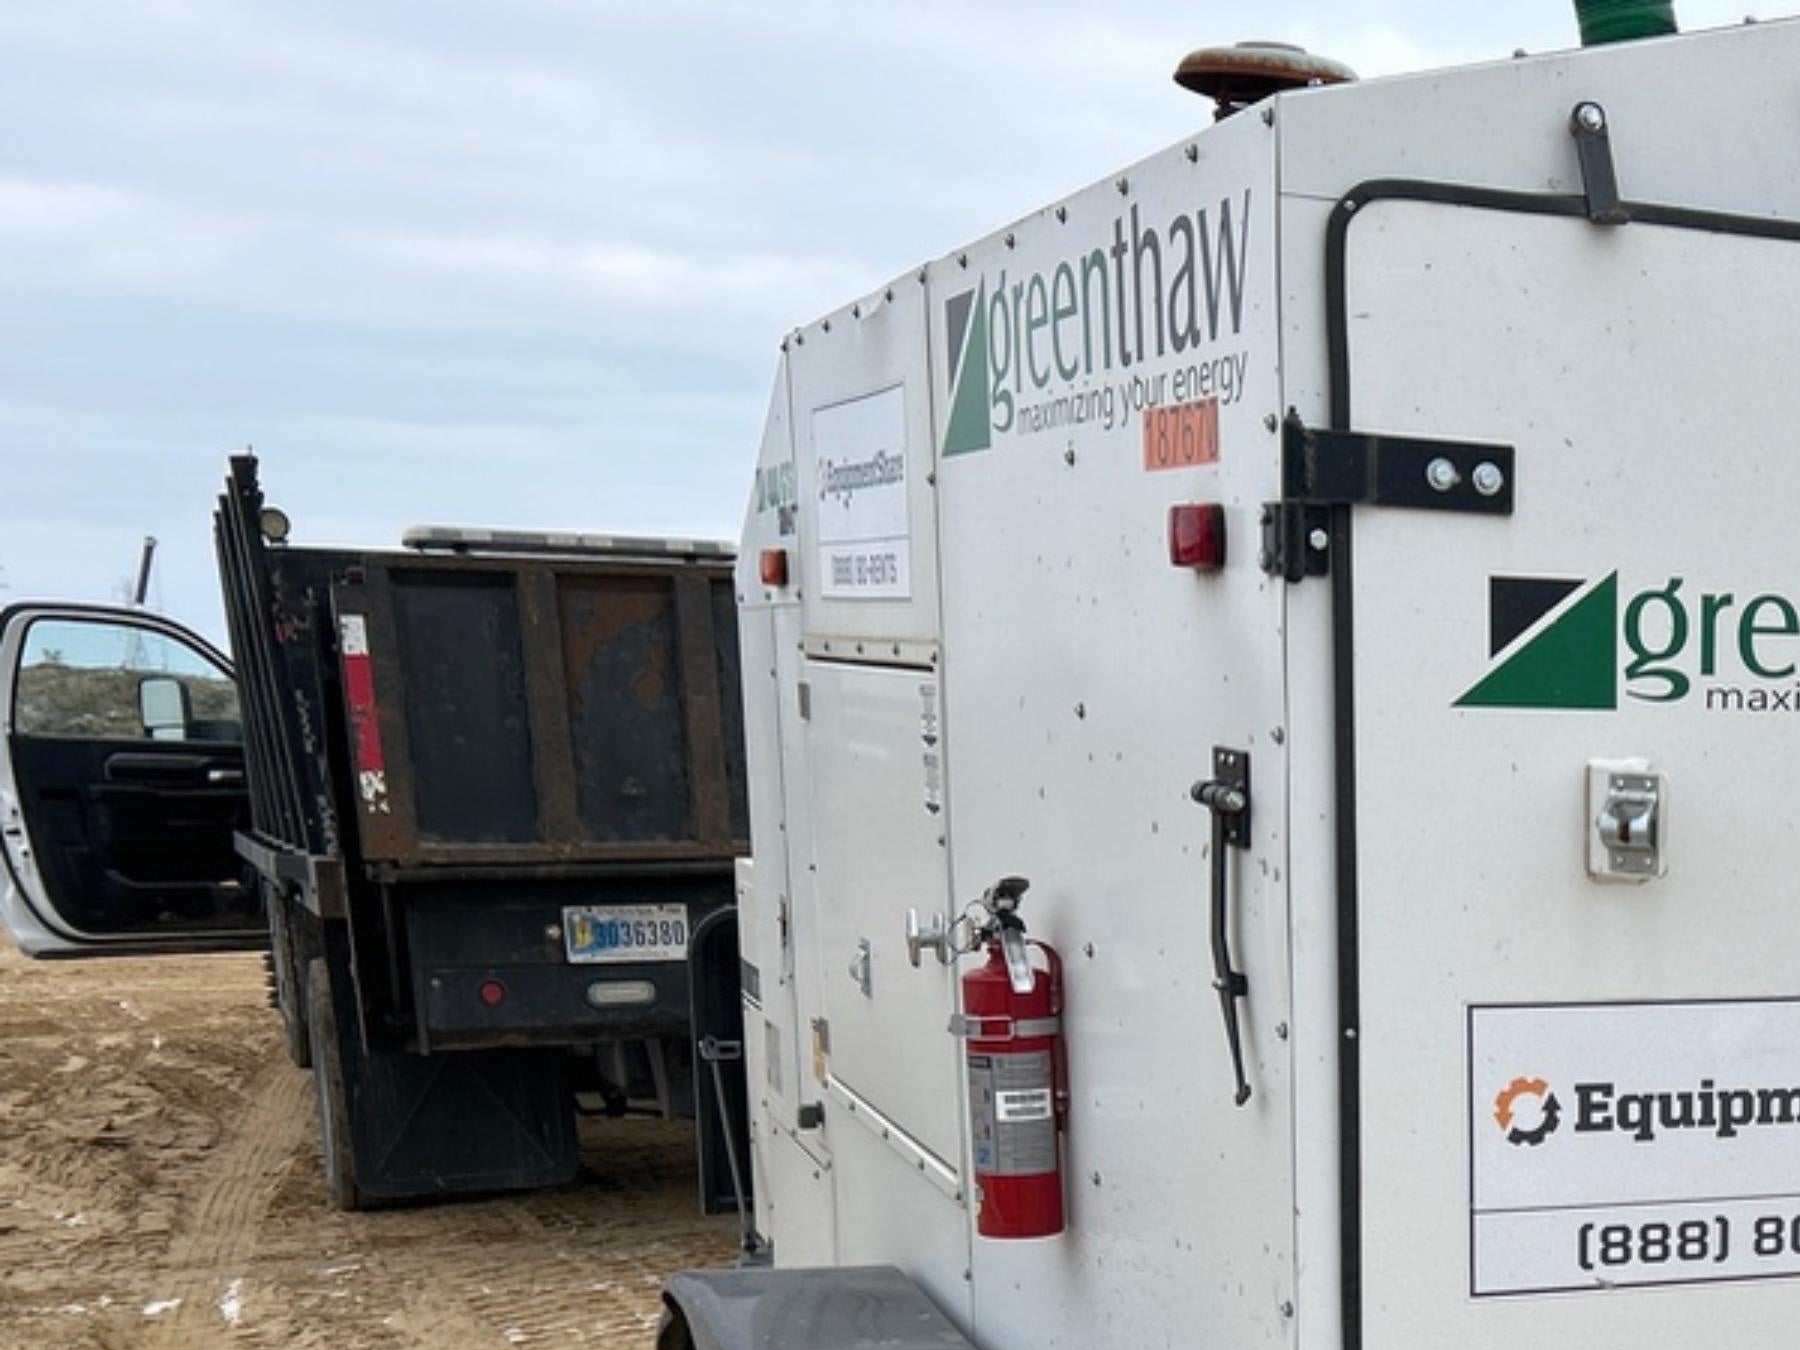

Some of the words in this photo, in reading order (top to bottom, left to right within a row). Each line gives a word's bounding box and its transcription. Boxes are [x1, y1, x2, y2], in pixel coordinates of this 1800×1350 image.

[986, 188, 1251, 432] greenthaw
[1017, 379, 1114, 434] maximizing
[1121, 373, 1167, 427] your
[1173, 350, 1249, 404] energy
[1578, 1214, 1730, 1270] (888)
